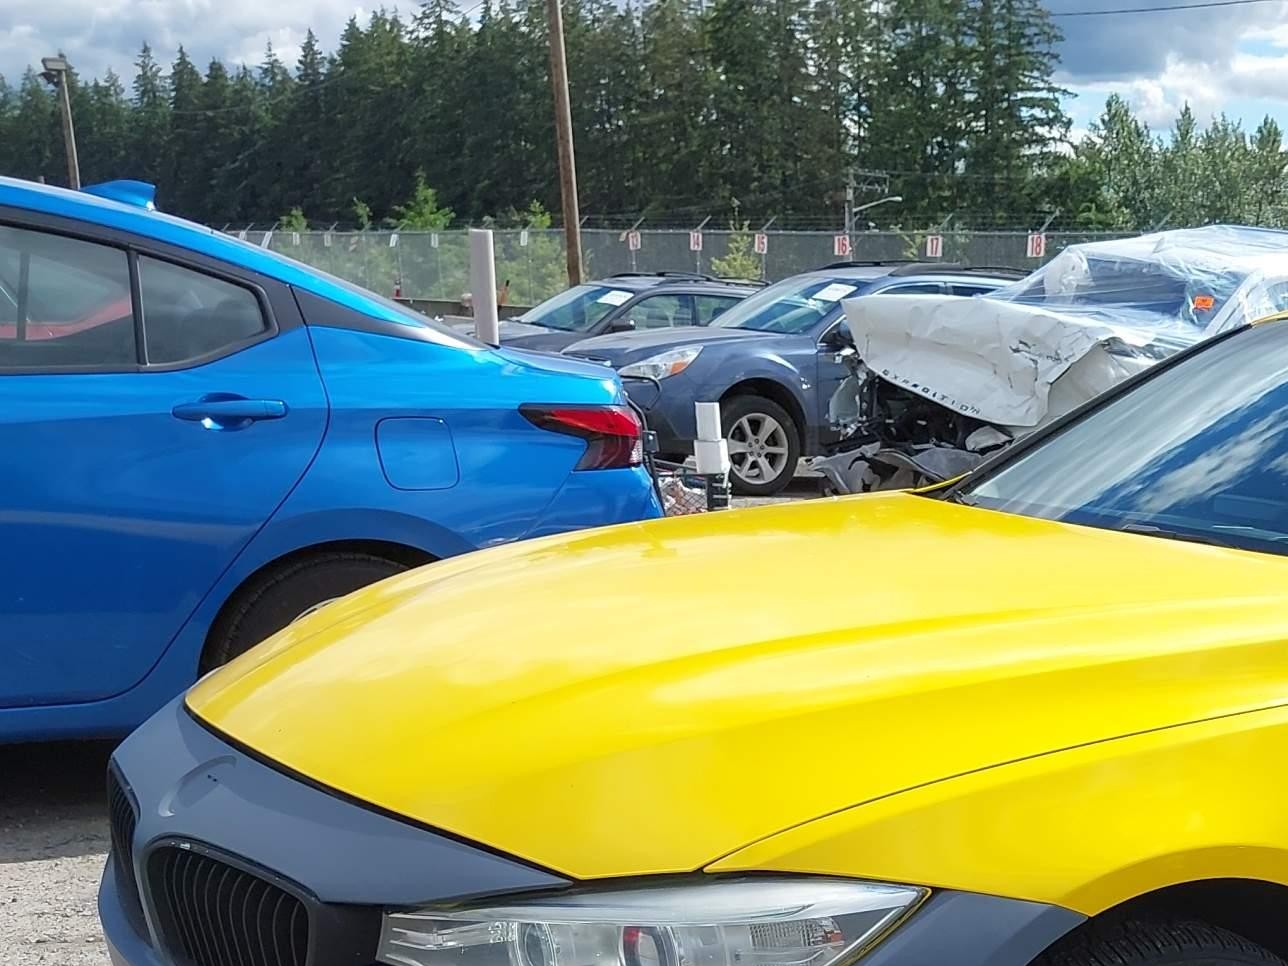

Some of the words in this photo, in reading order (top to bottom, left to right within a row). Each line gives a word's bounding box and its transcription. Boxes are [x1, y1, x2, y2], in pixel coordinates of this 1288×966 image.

[757, 234, 766, 251] 15
[836, 236, 847, 255] 16
[930, 237, 939, 255] 17
[1031, 235, 1042, 256] 18
[881, 368, 981, 415] EXPEDITION
